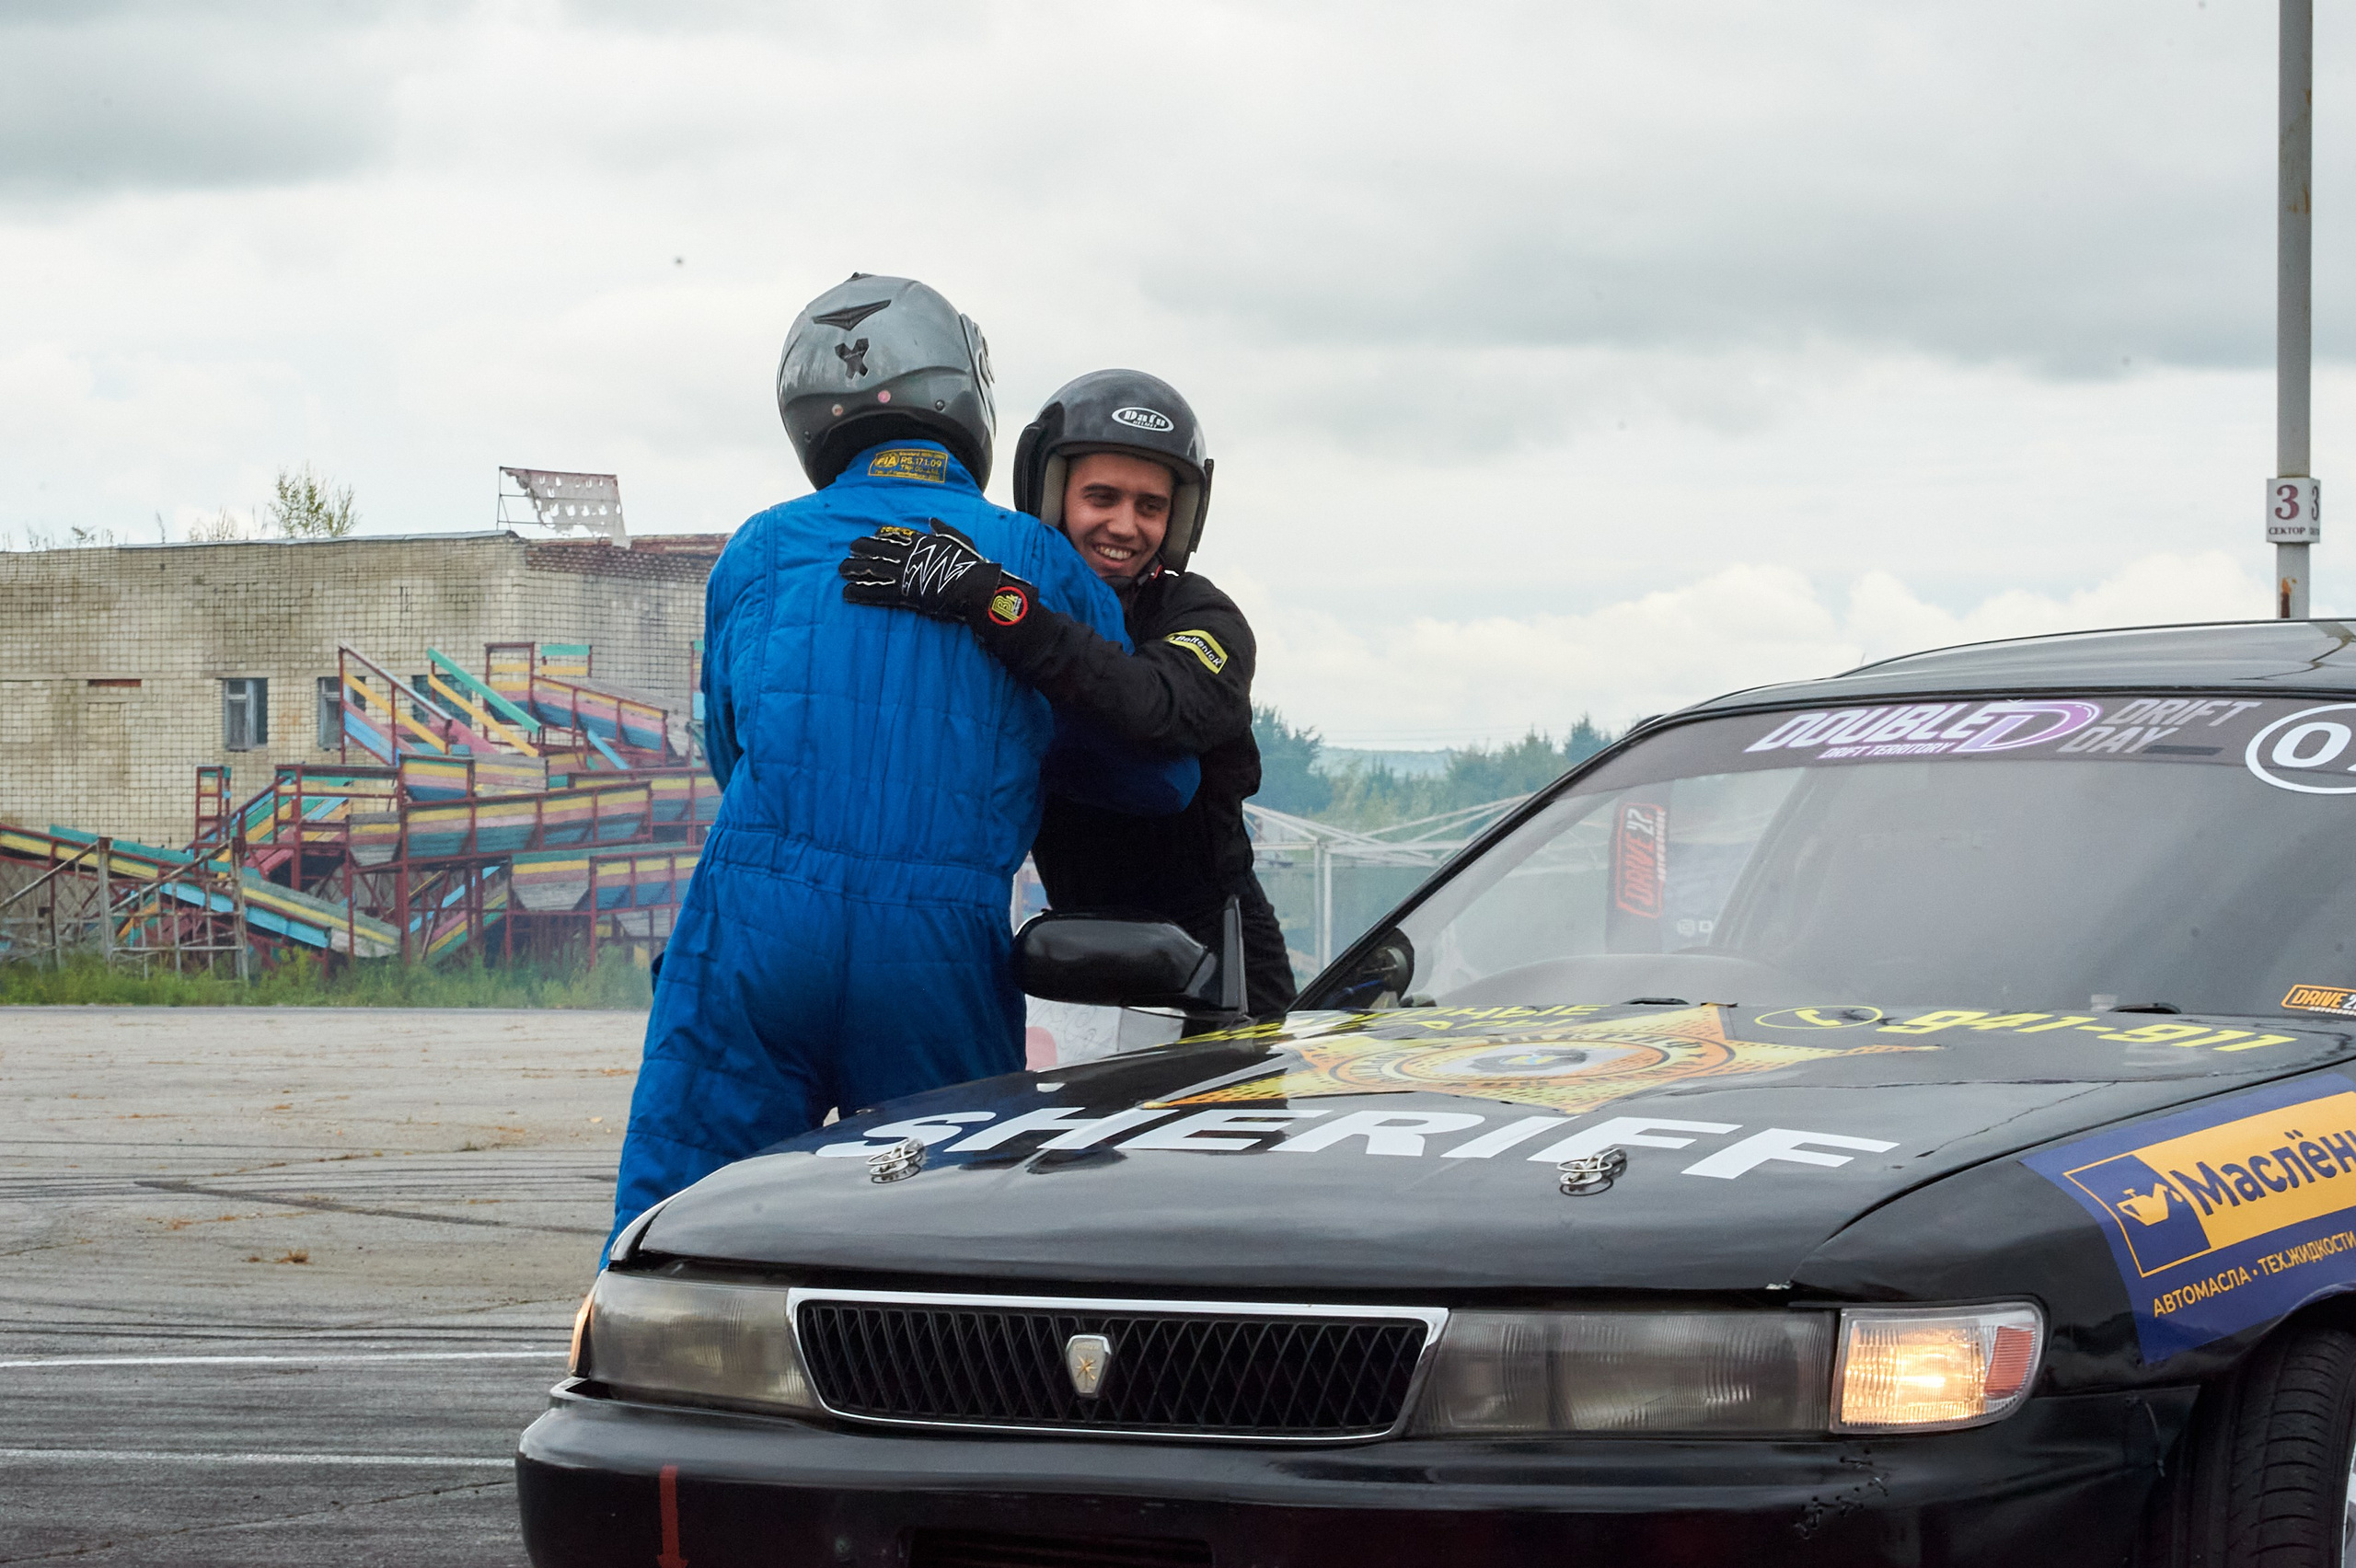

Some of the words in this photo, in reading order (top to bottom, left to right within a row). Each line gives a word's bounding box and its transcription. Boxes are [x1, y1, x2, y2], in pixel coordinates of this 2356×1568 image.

[875, 455, 897, 467] FIA
[2275, 484, 2300, 521] 3
[2102, 699, 2262, 726] DRIFT
[1818, 746, 1870, 760] DRIFT
[1866, 742, 1956, 756] TERRITORY
[2057, 726, 2179, 753] DAY
[2292, 989, 2349, 1009] DRIVE
[1877, 1010, 2298, 1052] 941-911
[815, 1107, 1901, 1180] SHERIFF
[2154, 1266, 2252, 1318] АВТОМАСЛА
